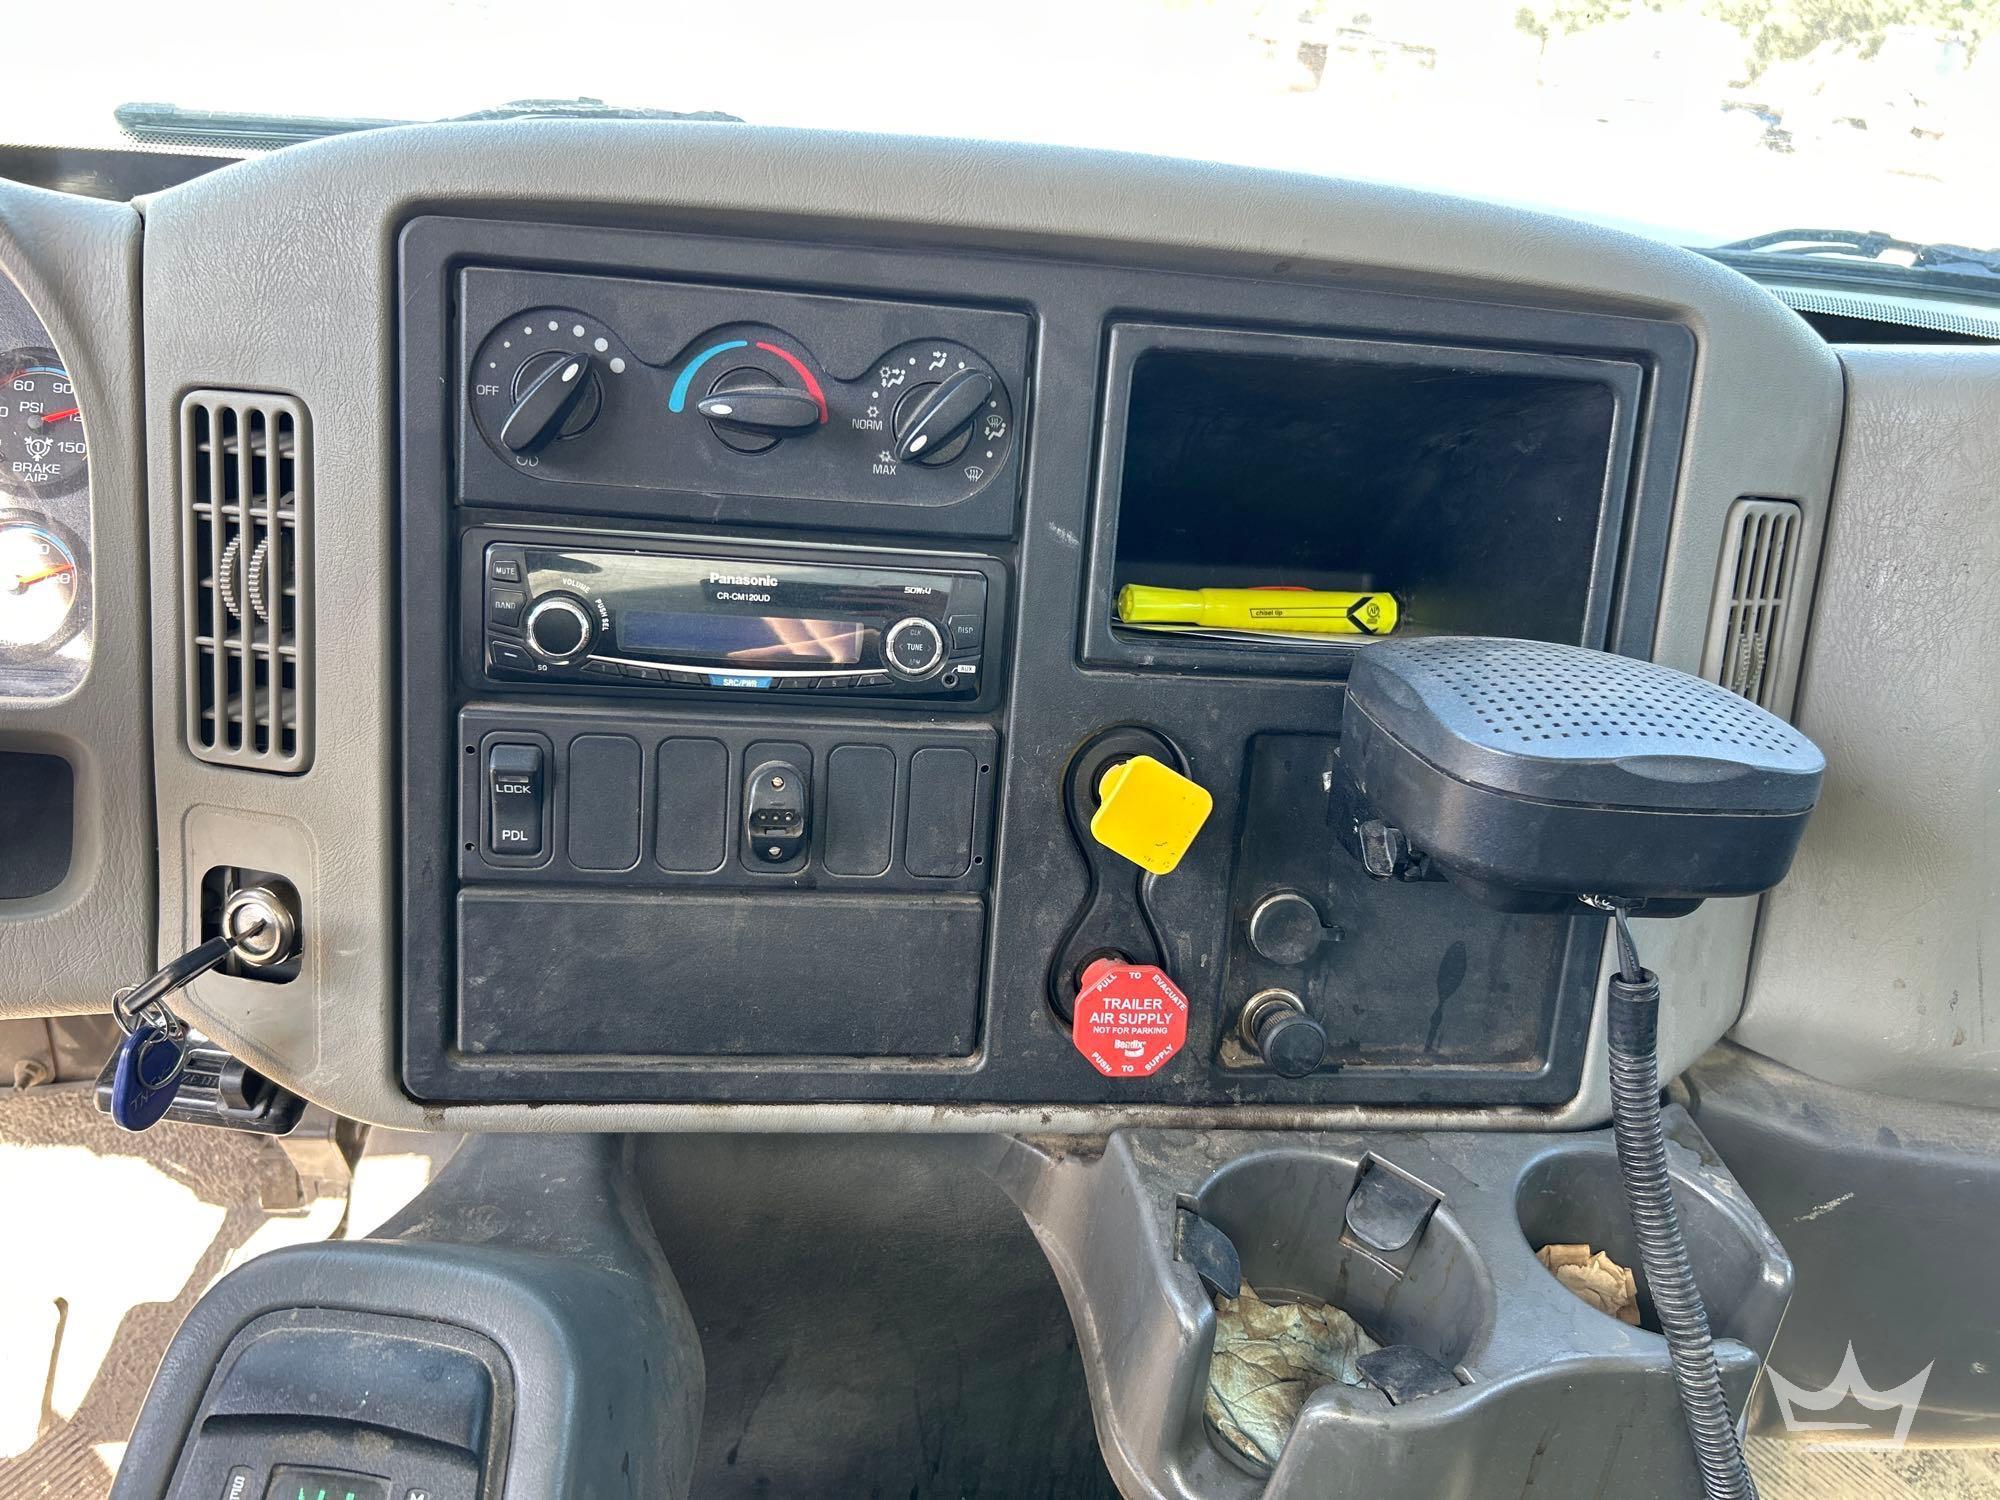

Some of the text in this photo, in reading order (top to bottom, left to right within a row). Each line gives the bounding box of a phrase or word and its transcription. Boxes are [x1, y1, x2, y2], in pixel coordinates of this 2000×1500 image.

[13, 379, 35, 392] 60
[52, 382, 75, 394] 90
[475, 384, 500, 396] OFF
[19, 401, 44, 413] PSI
[851, 418, 883, 431] NORM
[56, 441, 86, 454] 150
[12, 461, 61, 475] BRAKE
[872, 463, 897, 476] MAX
[23, 473, 49, 483] AIR
[495, 566, 515, 575] MUTE
[562, 577, 591, 594] VOLUME
[709, 572, 779, 587] Panasonic
[716, 591, 771, 602] CR-CM120UD
[594, 598, 610, 632] PUSH SEL
[957, 626, 974, 634] DISP
[906, 643, 923, 651] TUNE
[641, 670, 647, 678] 2
[722, 678, 758, 687] SRC/PWR
[495, 784, 532, 794] LOCK
[502, 829, 528, 841] PDL
[1096, 971, 1188, 1012] PULL TO EVACUATE
[1102, 997, 1163, 1010] TRAILER
[1089, 1012, 1174, 1025] AIR SUPPLY
[1092, 1026, 1169, 1035] NOT FOR PARKING
[1091, 1043, 1175, 1073] PUSH TO SUPPLY
